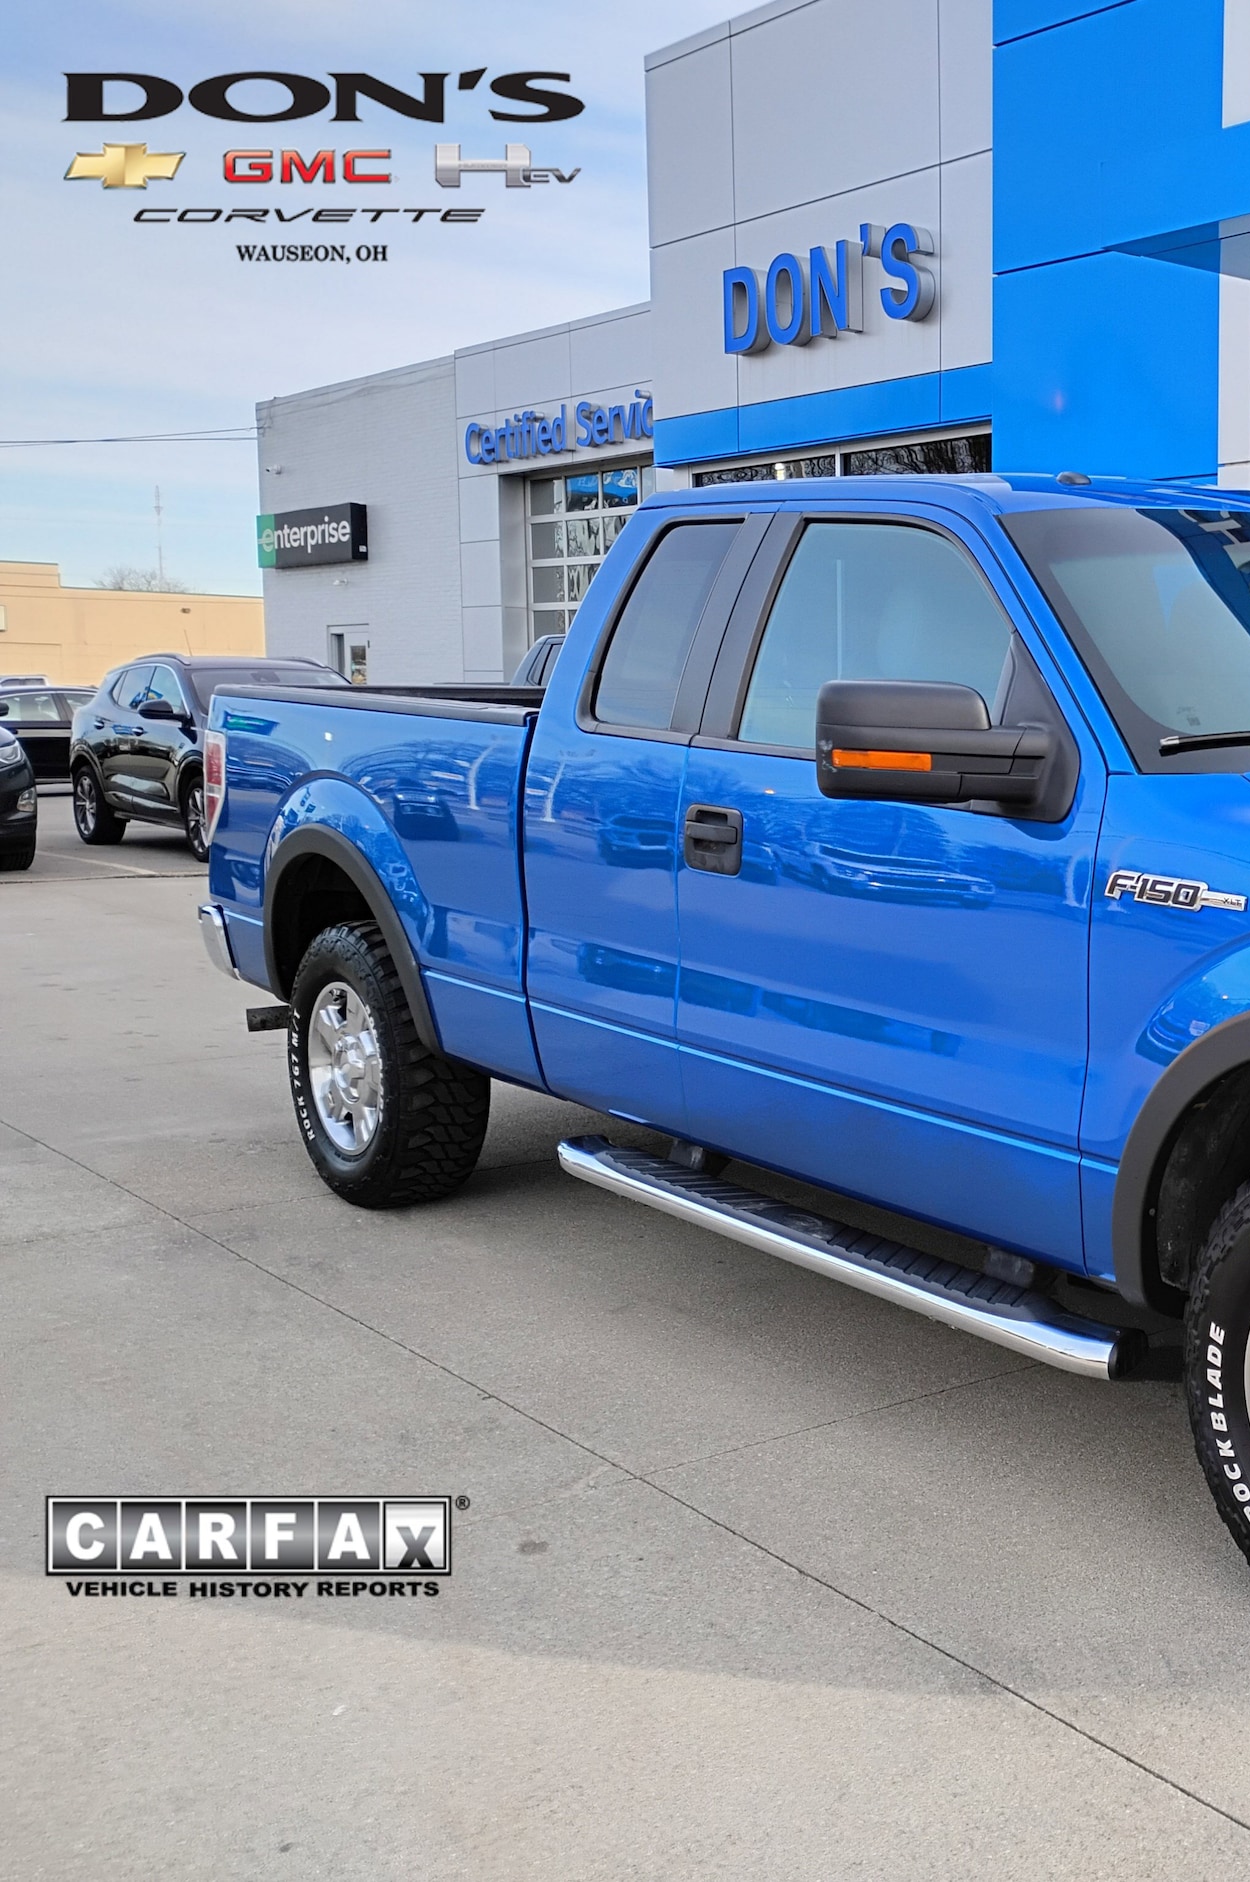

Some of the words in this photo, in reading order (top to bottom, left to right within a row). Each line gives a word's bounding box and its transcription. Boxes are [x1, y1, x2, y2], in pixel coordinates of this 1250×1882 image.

[723, 222, 928, 355] DON'S
[465, 404, 567, 464] Certified
[258, 515, 350, 553] enterprise
[1106, 871, 1203, 908] F-150
[296, 1096, 317, 1141] ROCK
